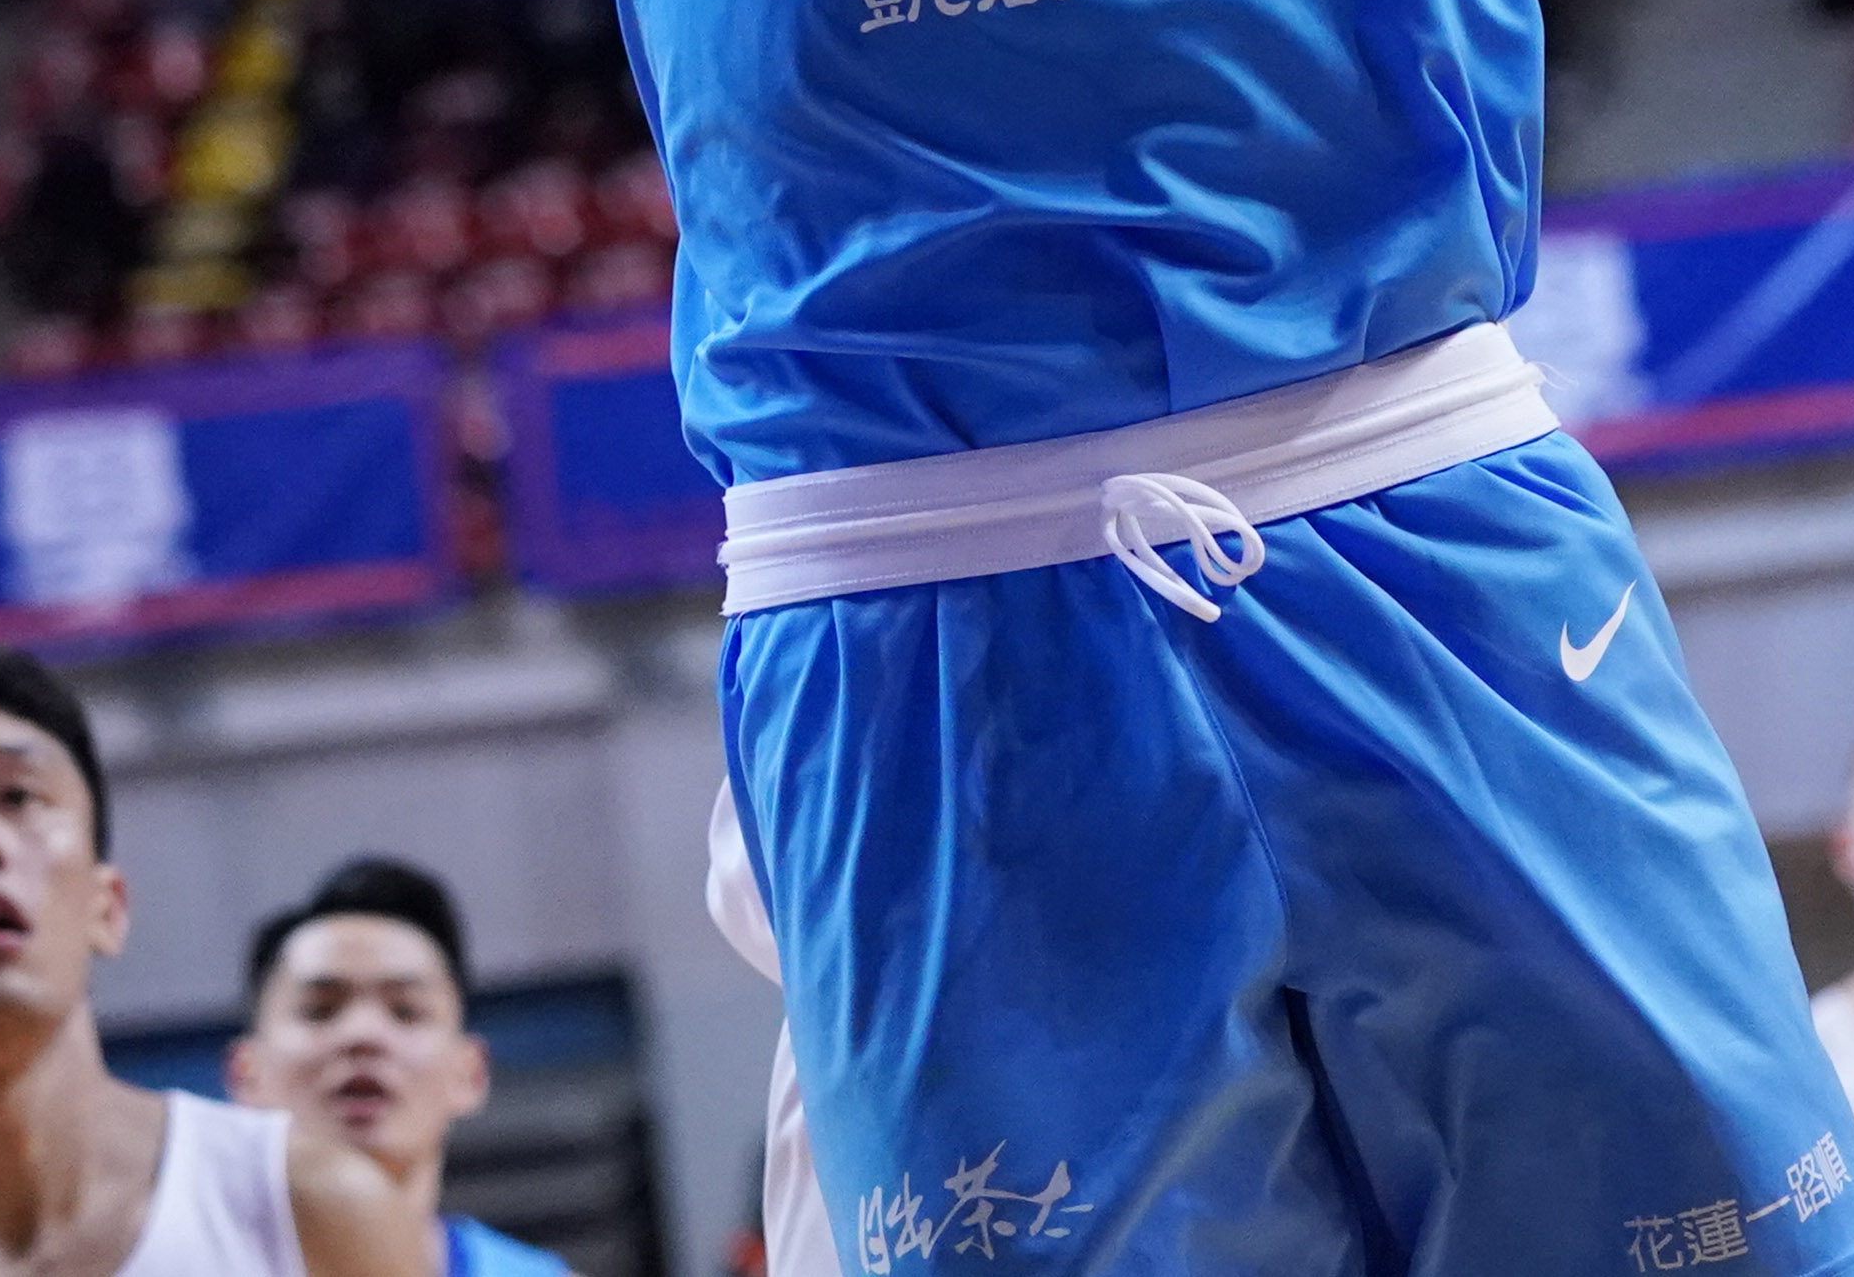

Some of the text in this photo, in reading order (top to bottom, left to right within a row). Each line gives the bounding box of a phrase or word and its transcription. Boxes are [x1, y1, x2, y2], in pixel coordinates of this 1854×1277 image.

[1623, 1130, 1853, 1273] 花蓮一路順
